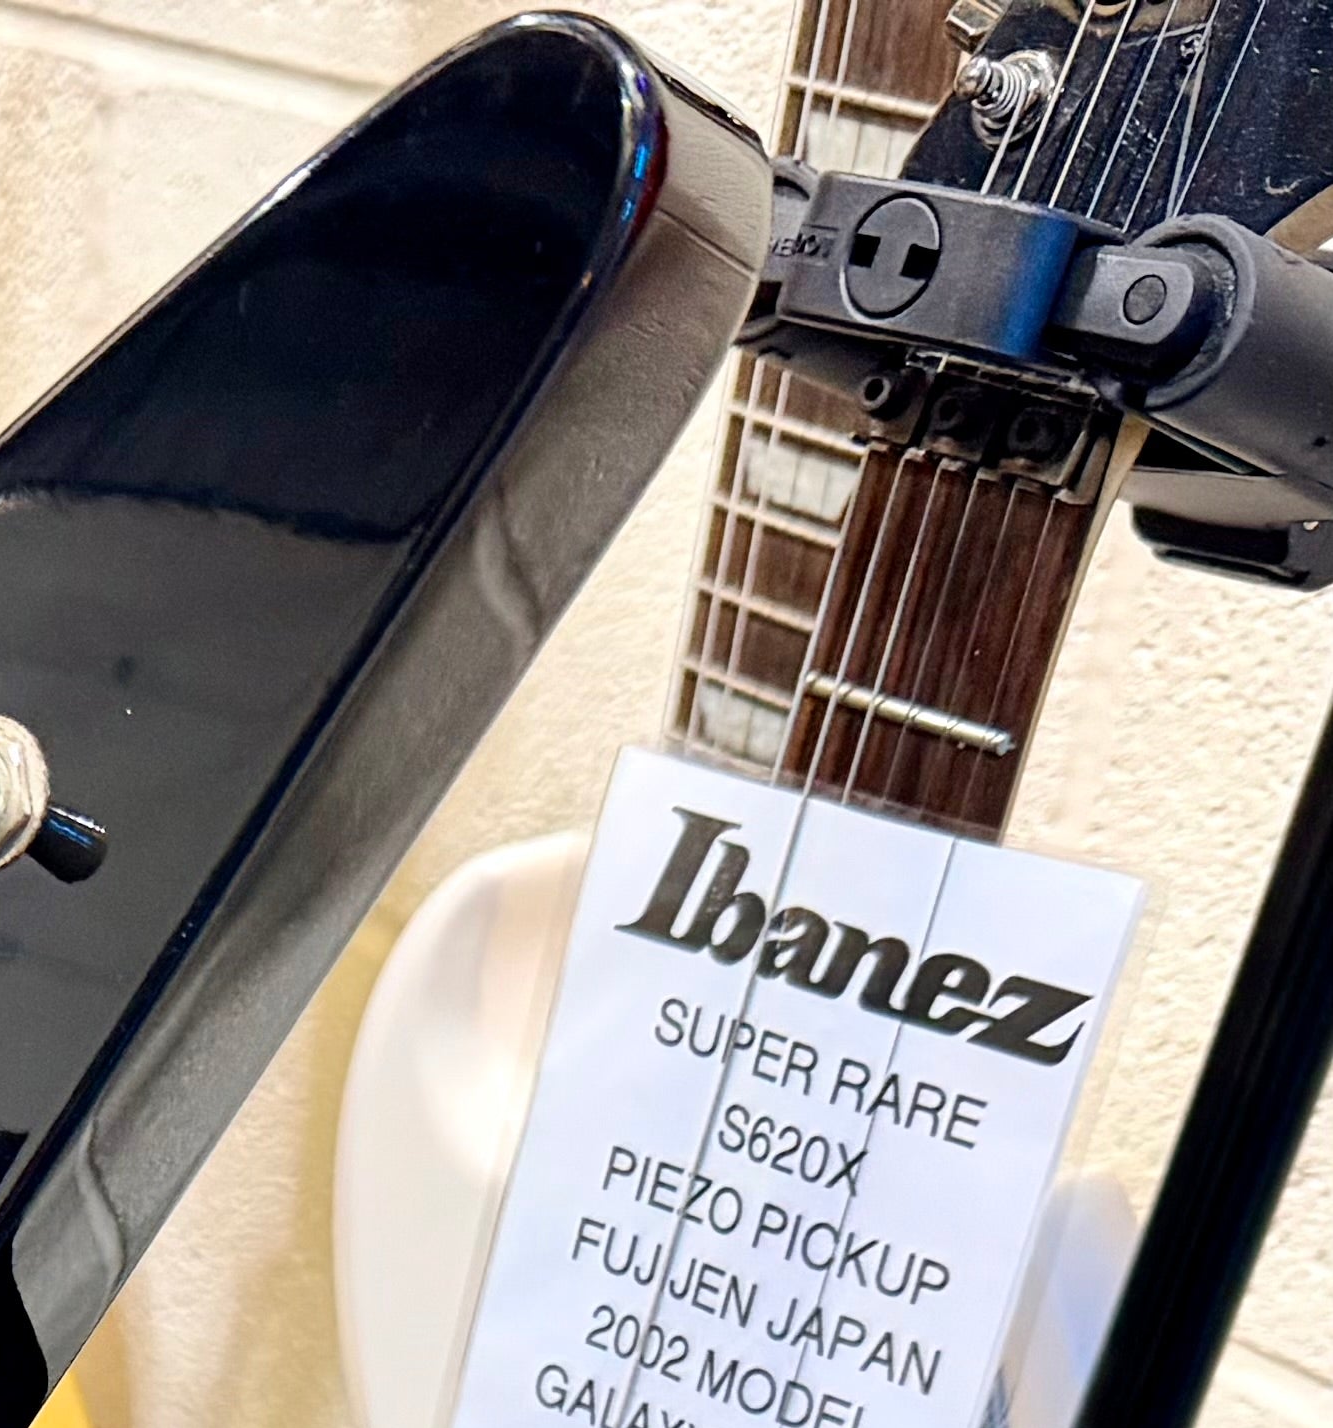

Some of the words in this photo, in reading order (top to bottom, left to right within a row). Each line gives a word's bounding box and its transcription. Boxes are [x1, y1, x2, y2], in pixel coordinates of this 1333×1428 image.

[614, 805, 1094, 1068] Ibanez
[654, 998, 819, 1096] SUPER
[828, 1057, 989, 1149] RARE
[717, 1104, 870, 1197] S620X
[602, 1145, 744, 1236] PIEZO
[751, 1203, 950, 1304] PICKUP
[585, 1304, 690, 1383] 2002
[766, 1298, 942, 1396] JAPAN
